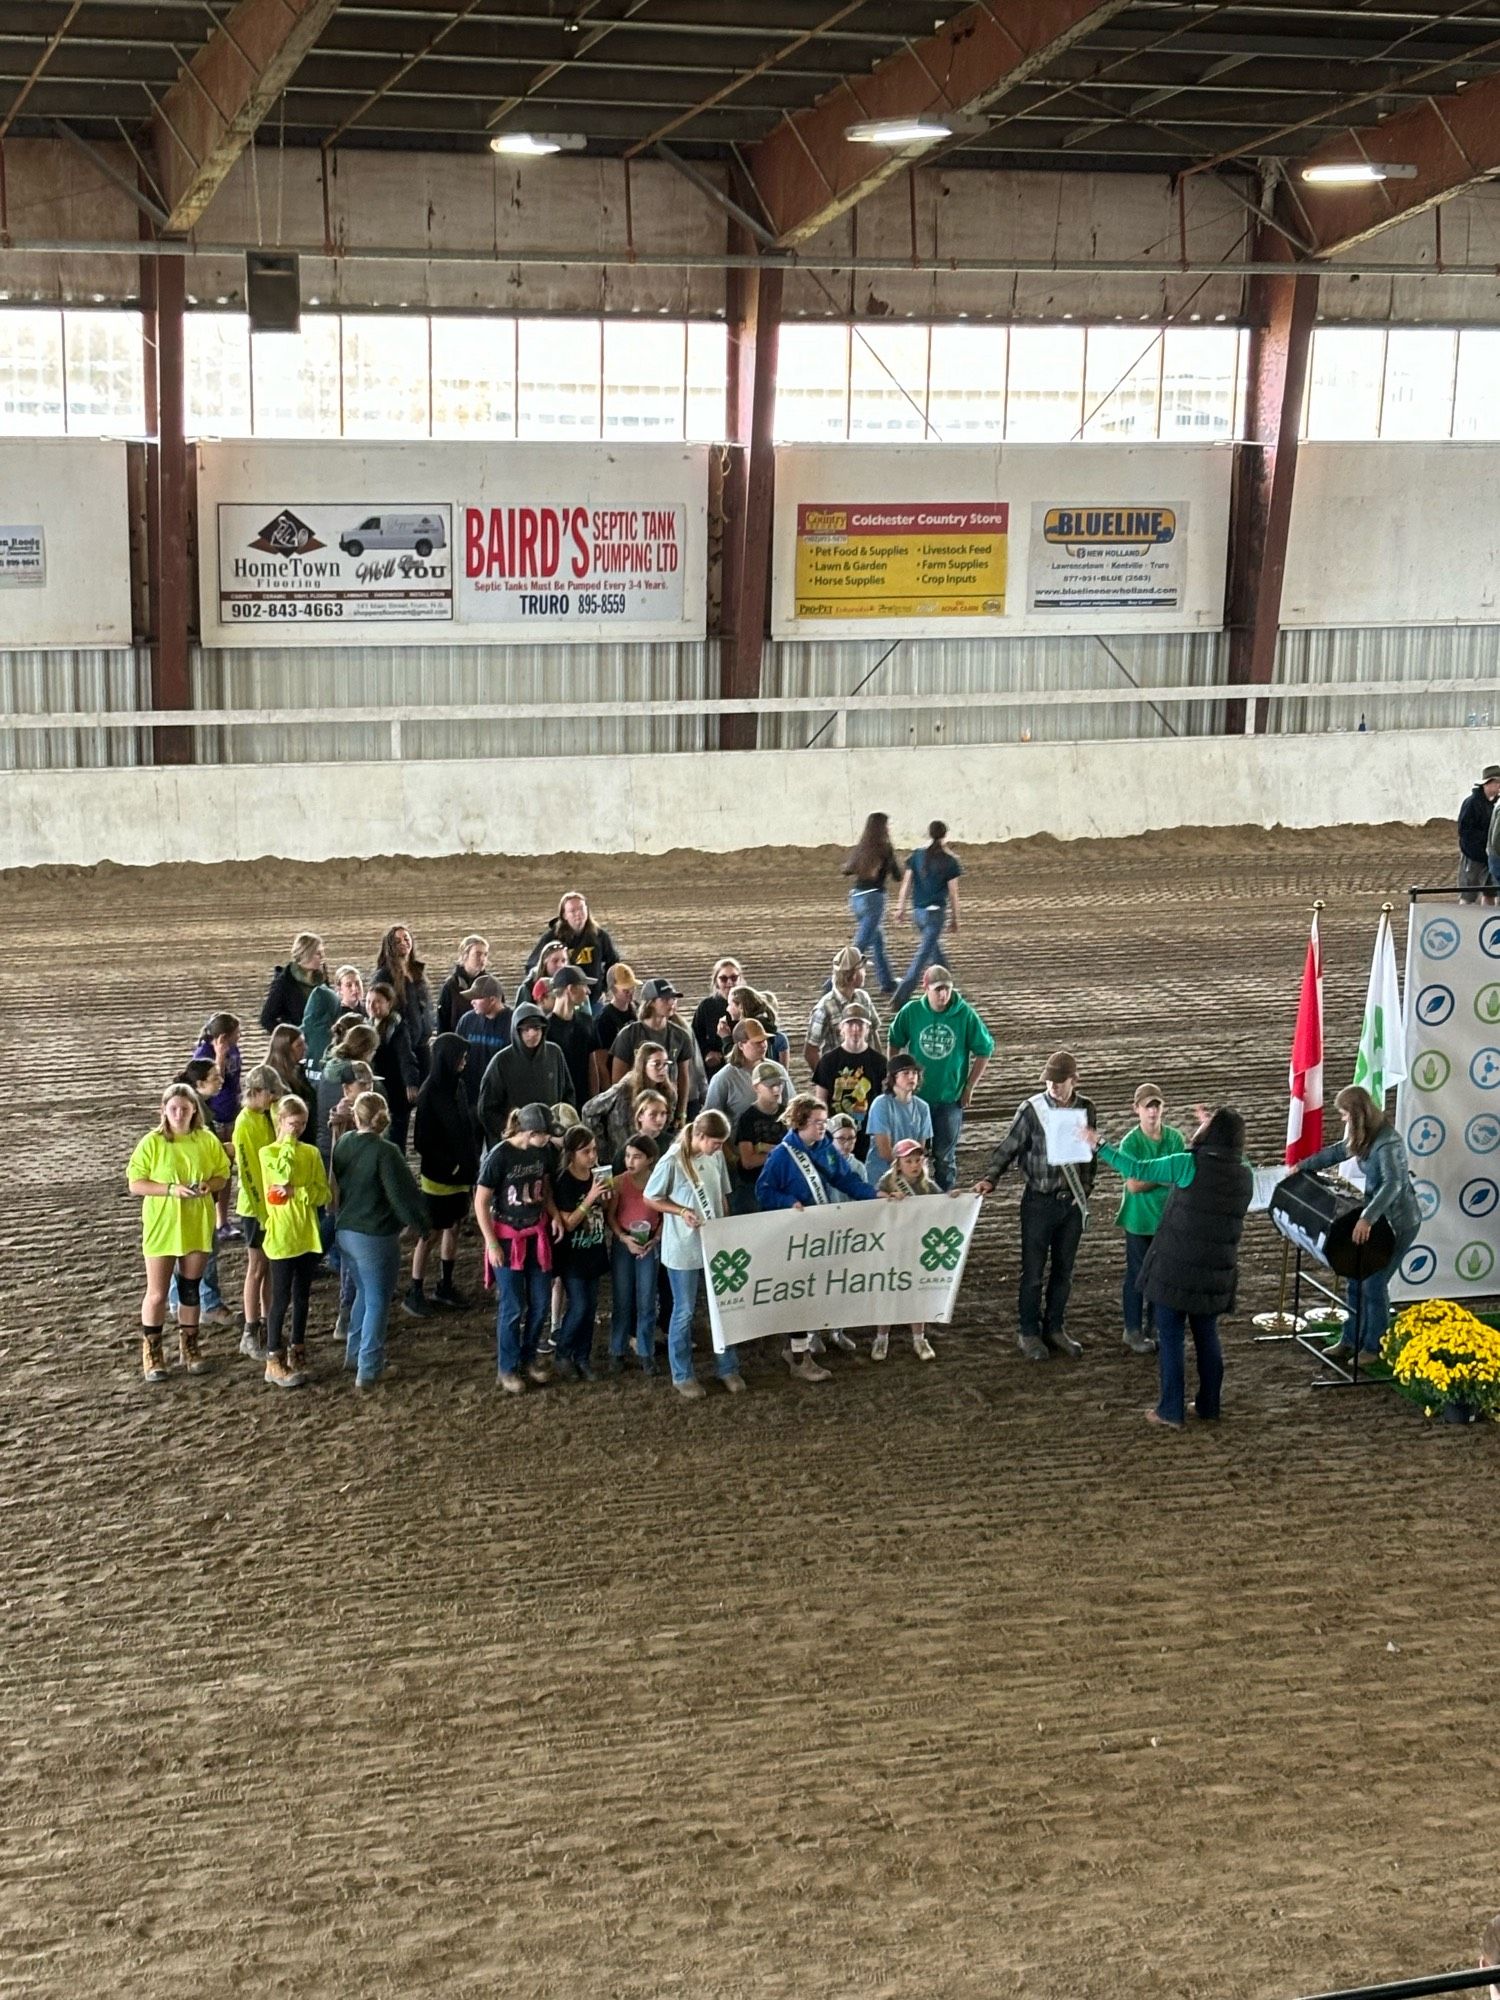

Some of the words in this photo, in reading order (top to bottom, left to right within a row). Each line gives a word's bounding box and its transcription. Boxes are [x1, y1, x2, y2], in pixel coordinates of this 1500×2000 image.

[592, 511, 638, 541] SEPTIC
[642, 511, 676, 541] TANK
[852, 514, 914, 526] Colchester
[917, 513, 967, 527] Country
[970, 513, 1003, 525] Store
[1058, 512, 1163, 536] BLUELINE
[466, 507, 590, 579] BAIRD'S
[815, 546, 831, 556] Pet
[834, 546, 858, 556] Food
[860, 546, 868, 556] &
[869, 546, 909, 558] Supplies
[923, 545, 967, 555] Livestock
[969, 545, 992, 554] Feed
[1087, 549, 1104, 557] NEW
[593, 543, 652, 573] PUMPING
[656, 542, 678, 573] LTD
[234, 558, 340, 577] HomeTown
[815, 561, 841, 571] Lawn
[843, 561, 851, 571] &
[853, 560, 888, 571] Garden
[922, 560, 947, 569] Farm
[948, 559, 989, 571] Supplies
[1111, 561, 1143, 569] Kentville
[1150, 561, 1170, 569] Truro
[257, 578, 321, 589] Flooring
[474, 581, 501, 592] Septic
[504, 581, 528, 591] Tanks
[531, 580, 551, 591] Must
[554, 581, 565, 590] Be
[567, 580, 601, 592] Pumped
[603, 581, 626, 592] Every
[628, 580, 642, 590] 3-4
[814, 576, 843, 586] Horse
[845, 575, 885, 587] Supplies
[921, 574, 945, 585] Crop
[946, 574, 977, 585] Inputs
[232, 602, 343, 618] 902-843-4663
[519, 594, 569, 614] TRURO
[578, 594, 626, 614] 895-8559
[786, 1227, 885, 1261] Halifax
[752, 1273, 816, 1306] East
[825, 1266, 913, 1296] Hants
